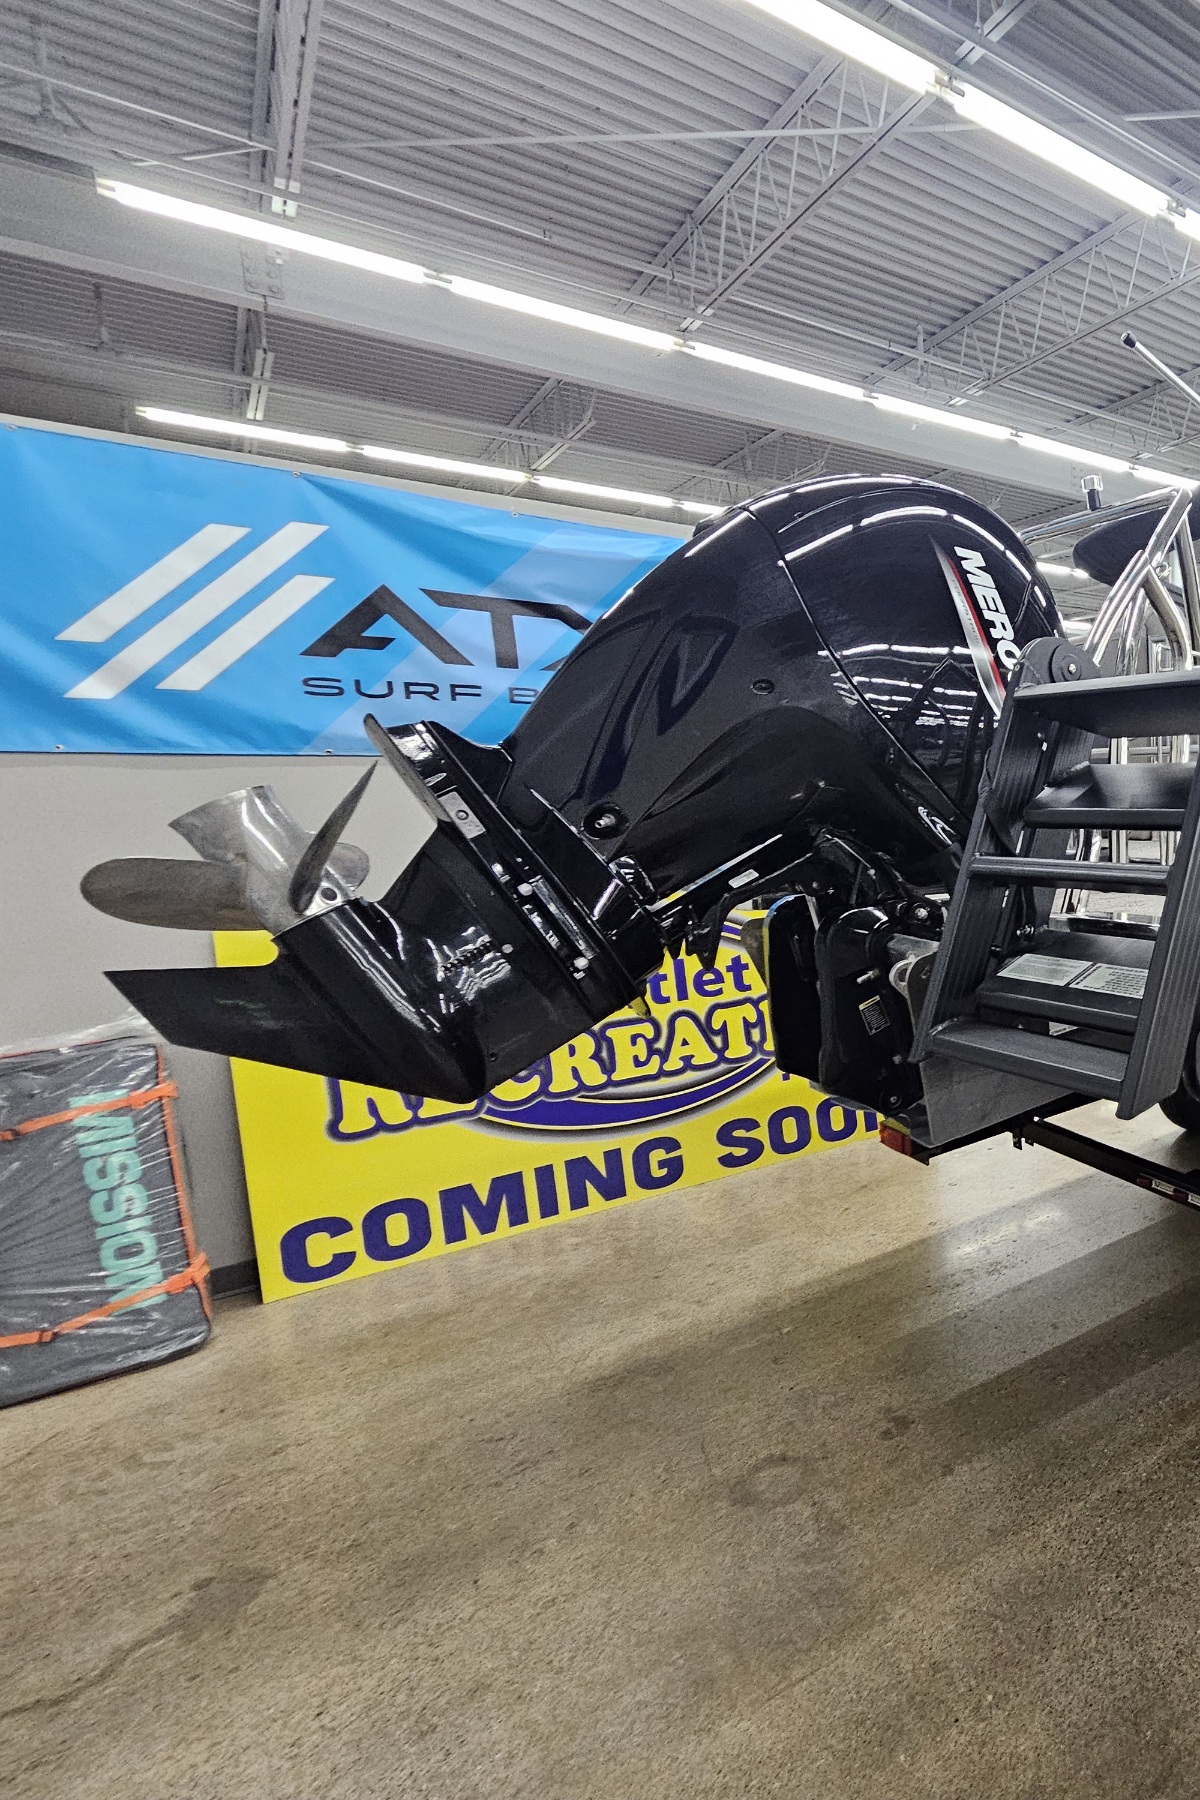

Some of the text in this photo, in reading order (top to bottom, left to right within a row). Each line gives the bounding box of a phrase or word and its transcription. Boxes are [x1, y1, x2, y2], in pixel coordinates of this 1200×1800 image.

[953, 545, 1022, 682] MERC
[301, 676, 483, 702] SURF
[67, 1088, 168, 1317] MISSION
[279, 1135, 685, 1285] COMING
